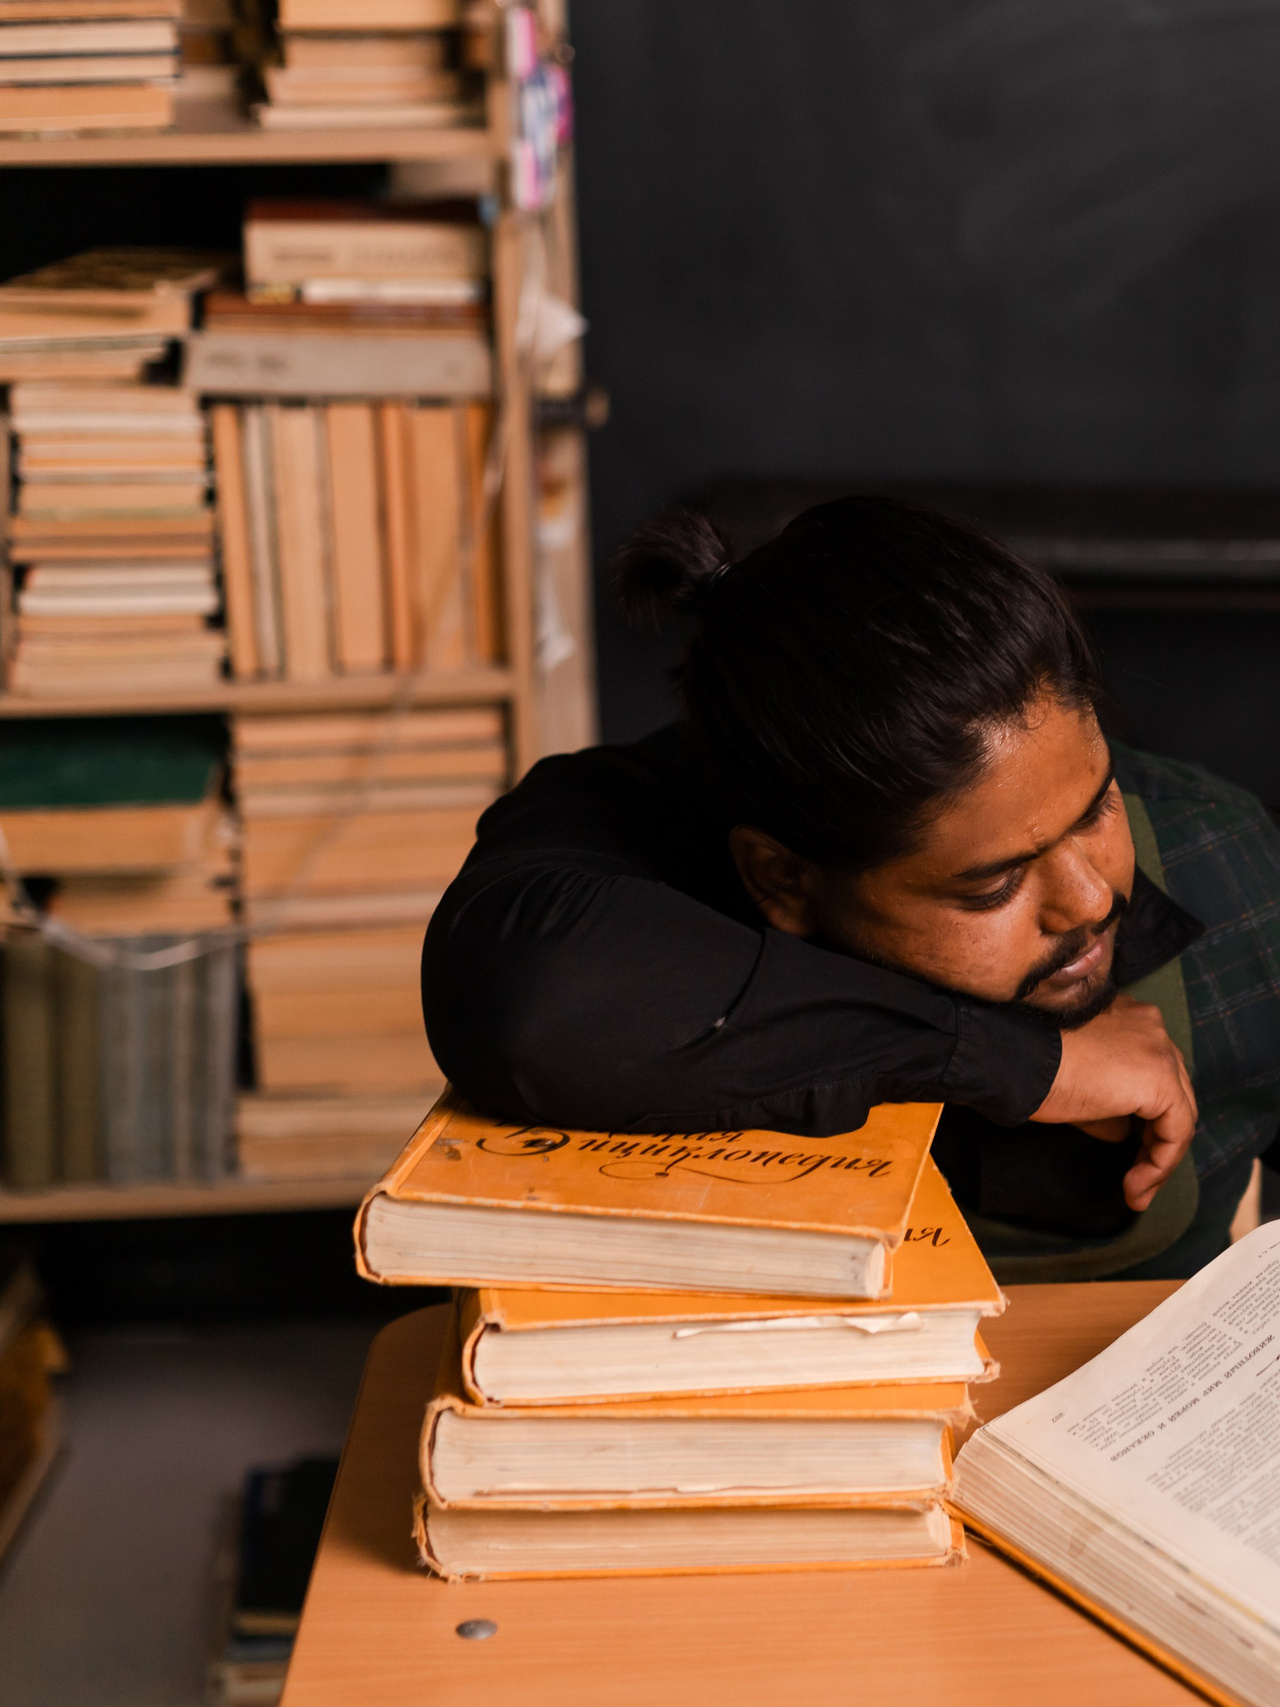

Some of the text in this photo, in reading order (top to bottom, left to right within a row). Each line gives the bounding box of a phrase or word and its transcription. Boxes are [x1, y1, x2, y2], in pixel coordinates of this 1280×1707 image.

[1110, 1334, 1275, 1462] ЖИВОТНЫЙ МИР МОРЕЙ И ОКЕАНОВ
